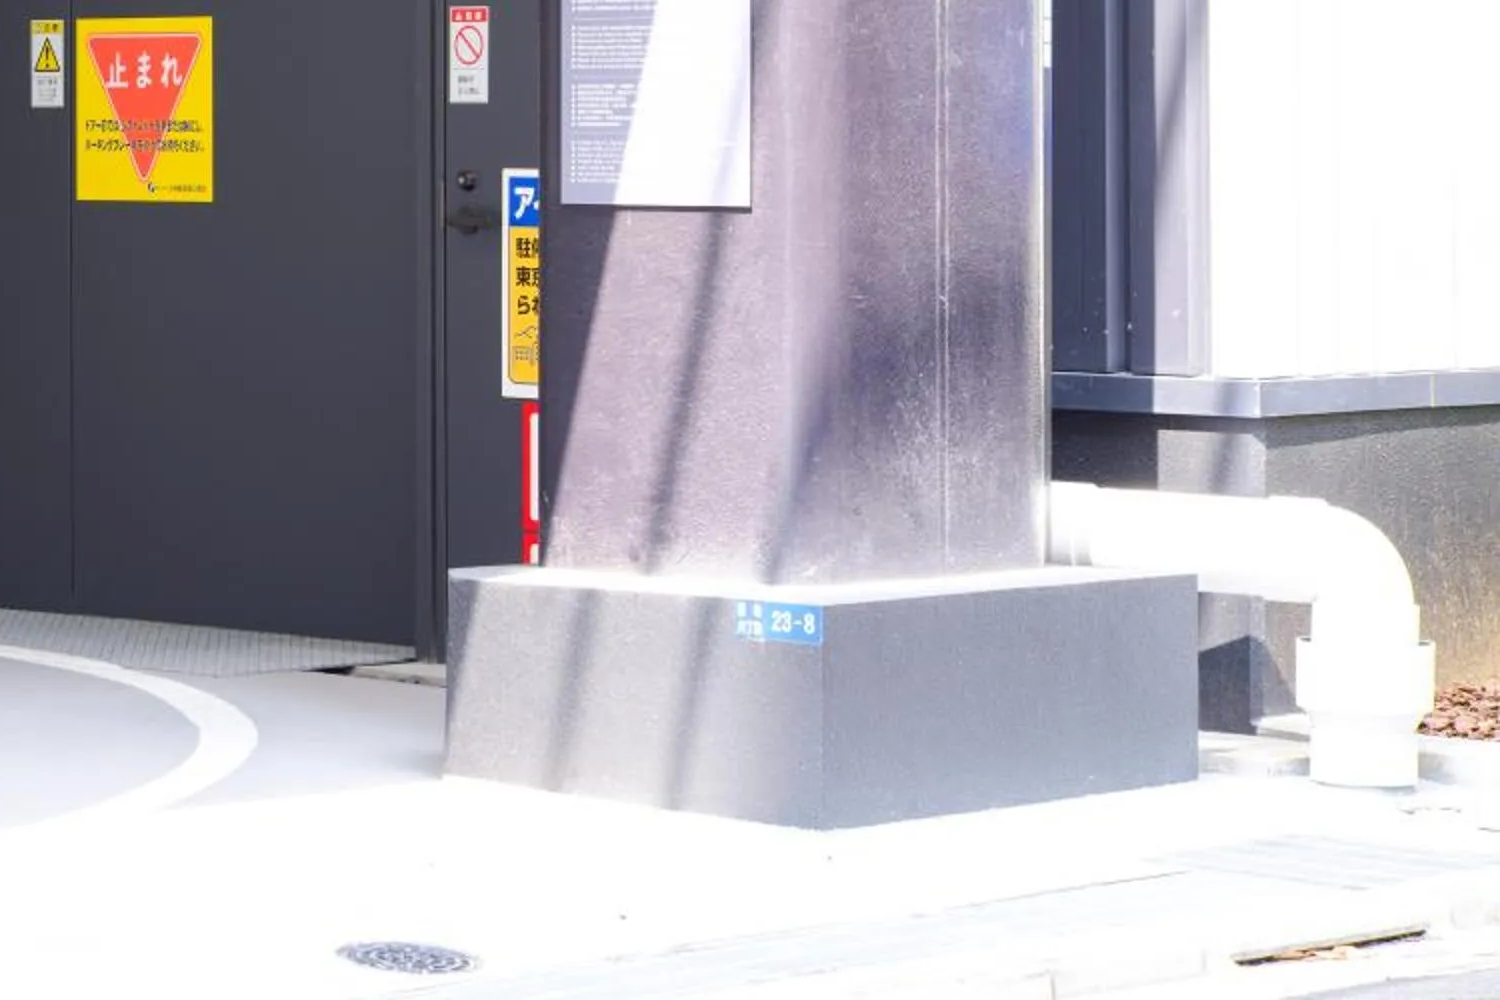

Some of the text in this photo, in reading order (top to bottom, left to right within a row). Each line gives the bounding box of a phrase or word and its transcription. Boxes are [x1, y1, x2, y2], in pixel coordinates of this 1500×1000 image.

[105, 51, 183, 89] 止まれ
[514, 187, 540, 219] ア
[771, 610, 815, 635] 23-8
